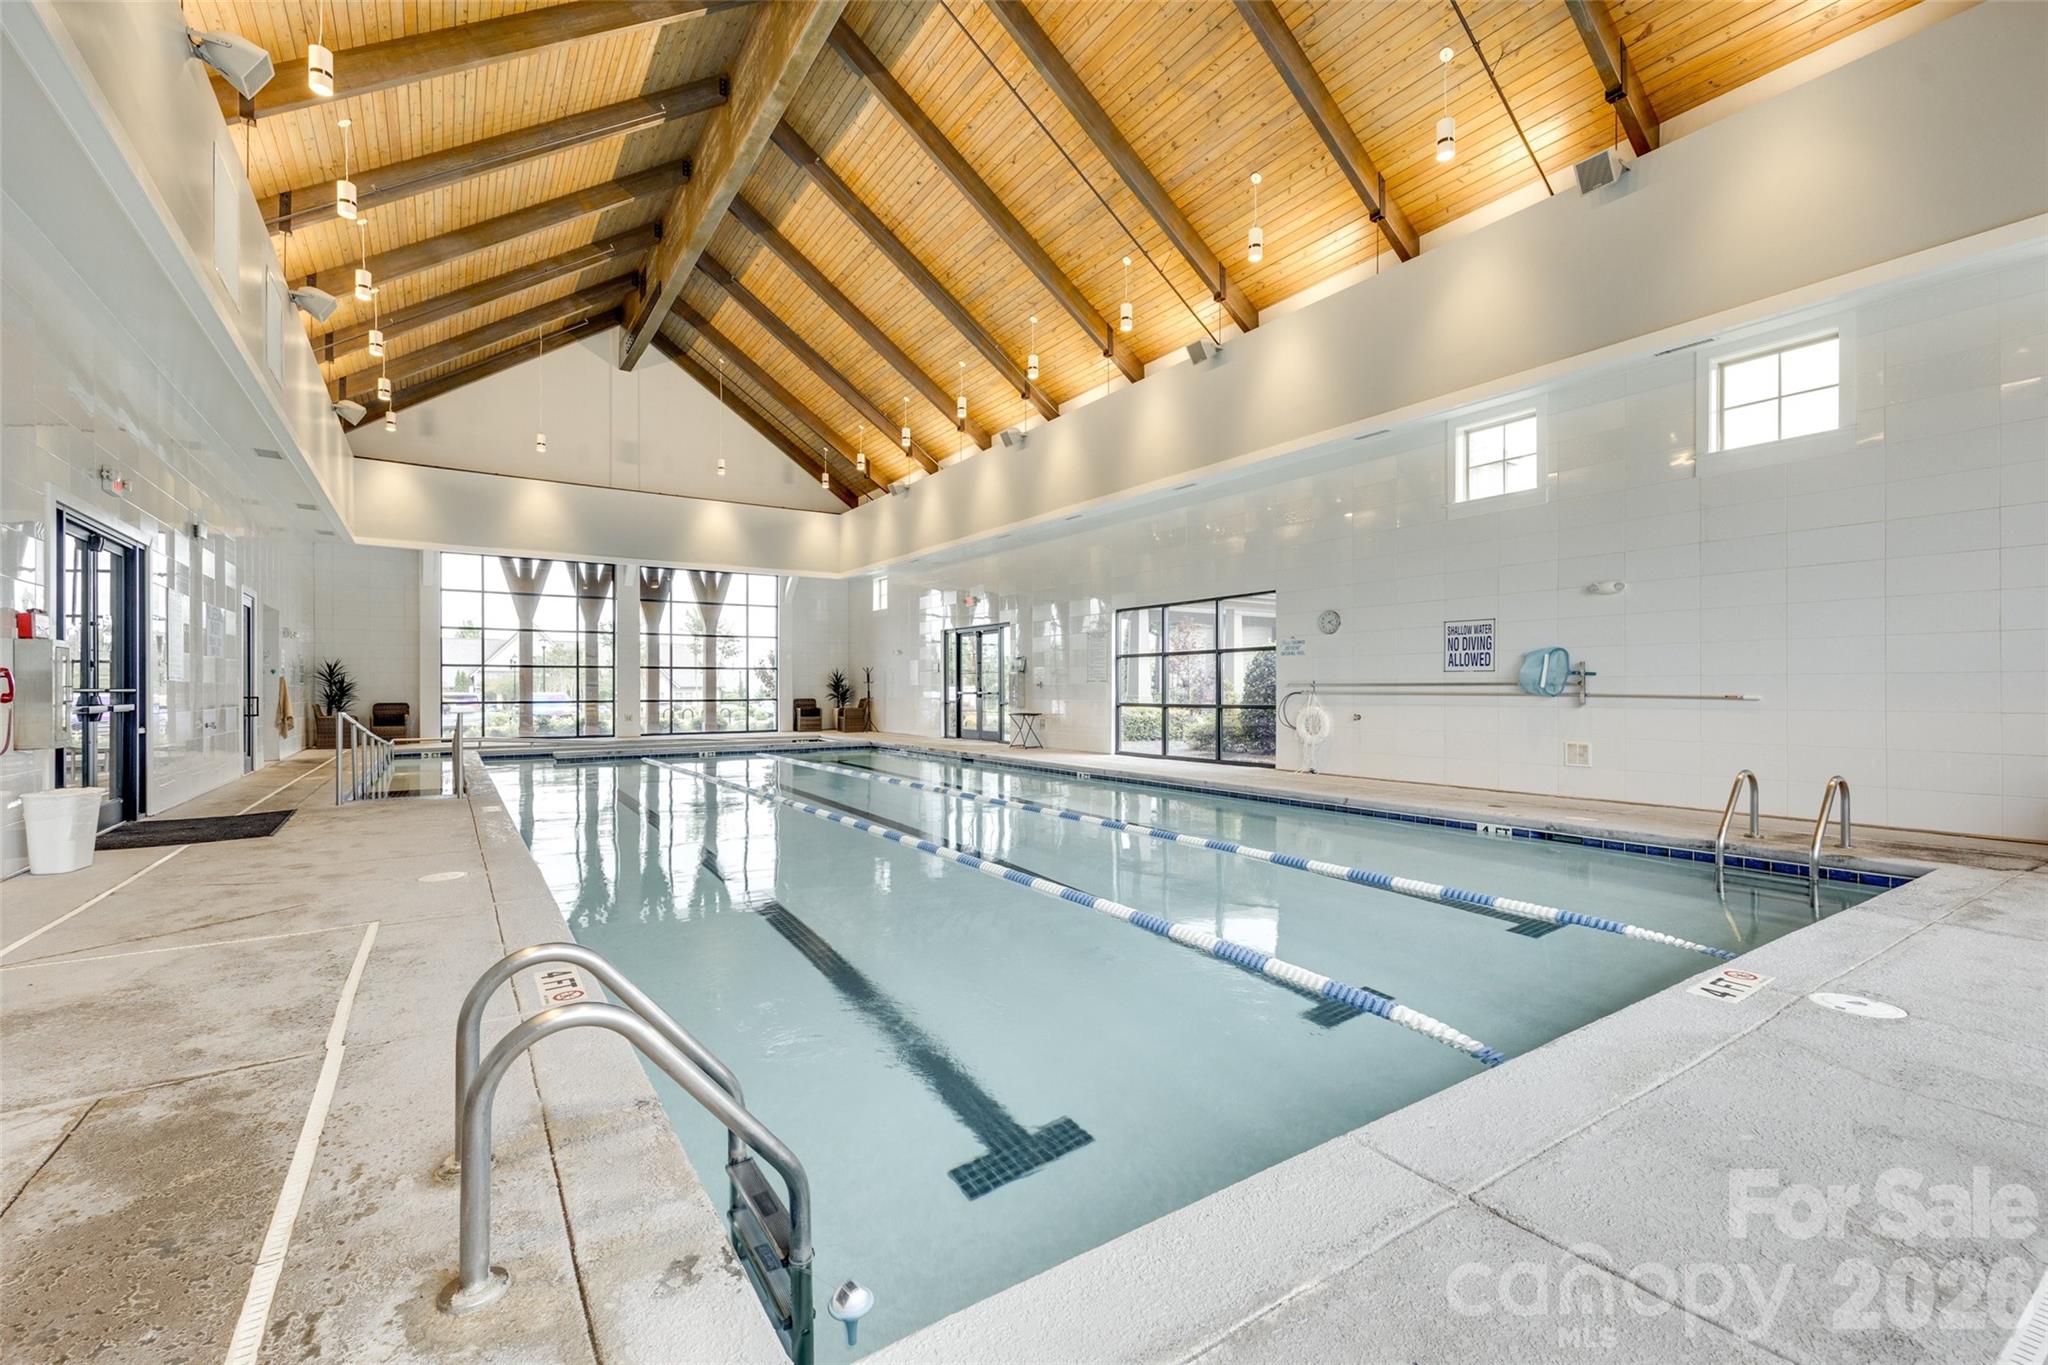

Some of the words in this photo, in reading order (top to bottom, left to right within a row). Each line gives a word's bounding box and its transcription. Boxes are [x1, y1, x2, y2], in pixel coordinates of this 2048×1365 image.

[1447, 625, 1472, 636] SHALLOW
[1473, 624, 1492, 634] WATER
[1447, 637, 1460, 651] NO
[1462, 636, 1492, 651] DIVING
[1448, 652, 1491, 667] ALLOWED
